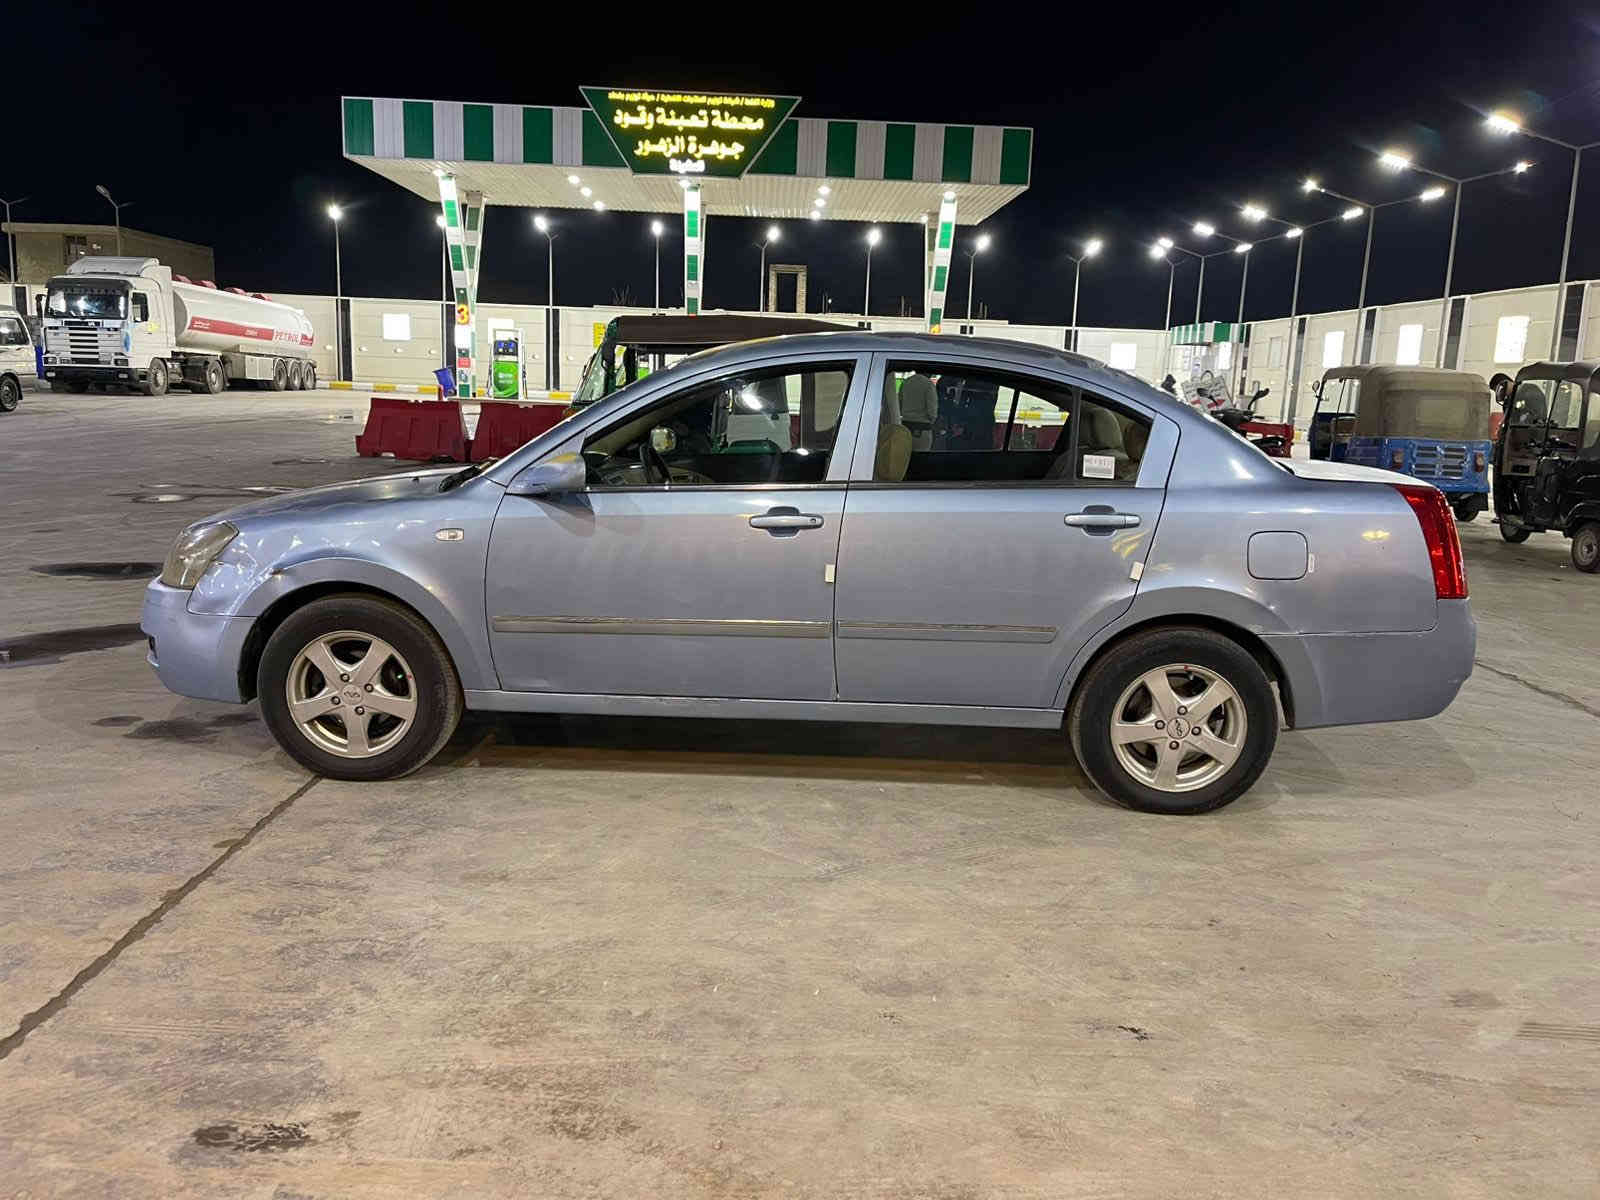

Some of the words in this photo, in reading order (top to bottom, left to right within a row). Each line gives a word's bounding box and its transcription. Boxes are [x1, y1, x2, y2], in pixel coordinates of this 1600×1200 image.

[613, 104, 655, 130] وقود
[655, 106, 709, 132] تعبئة
[711, 109, 764, 130] محطة
[633, 135, 685, 158] الزهور
[687, 135, 745, 160] جوهرة
[457, 303, 469, 325] 3
